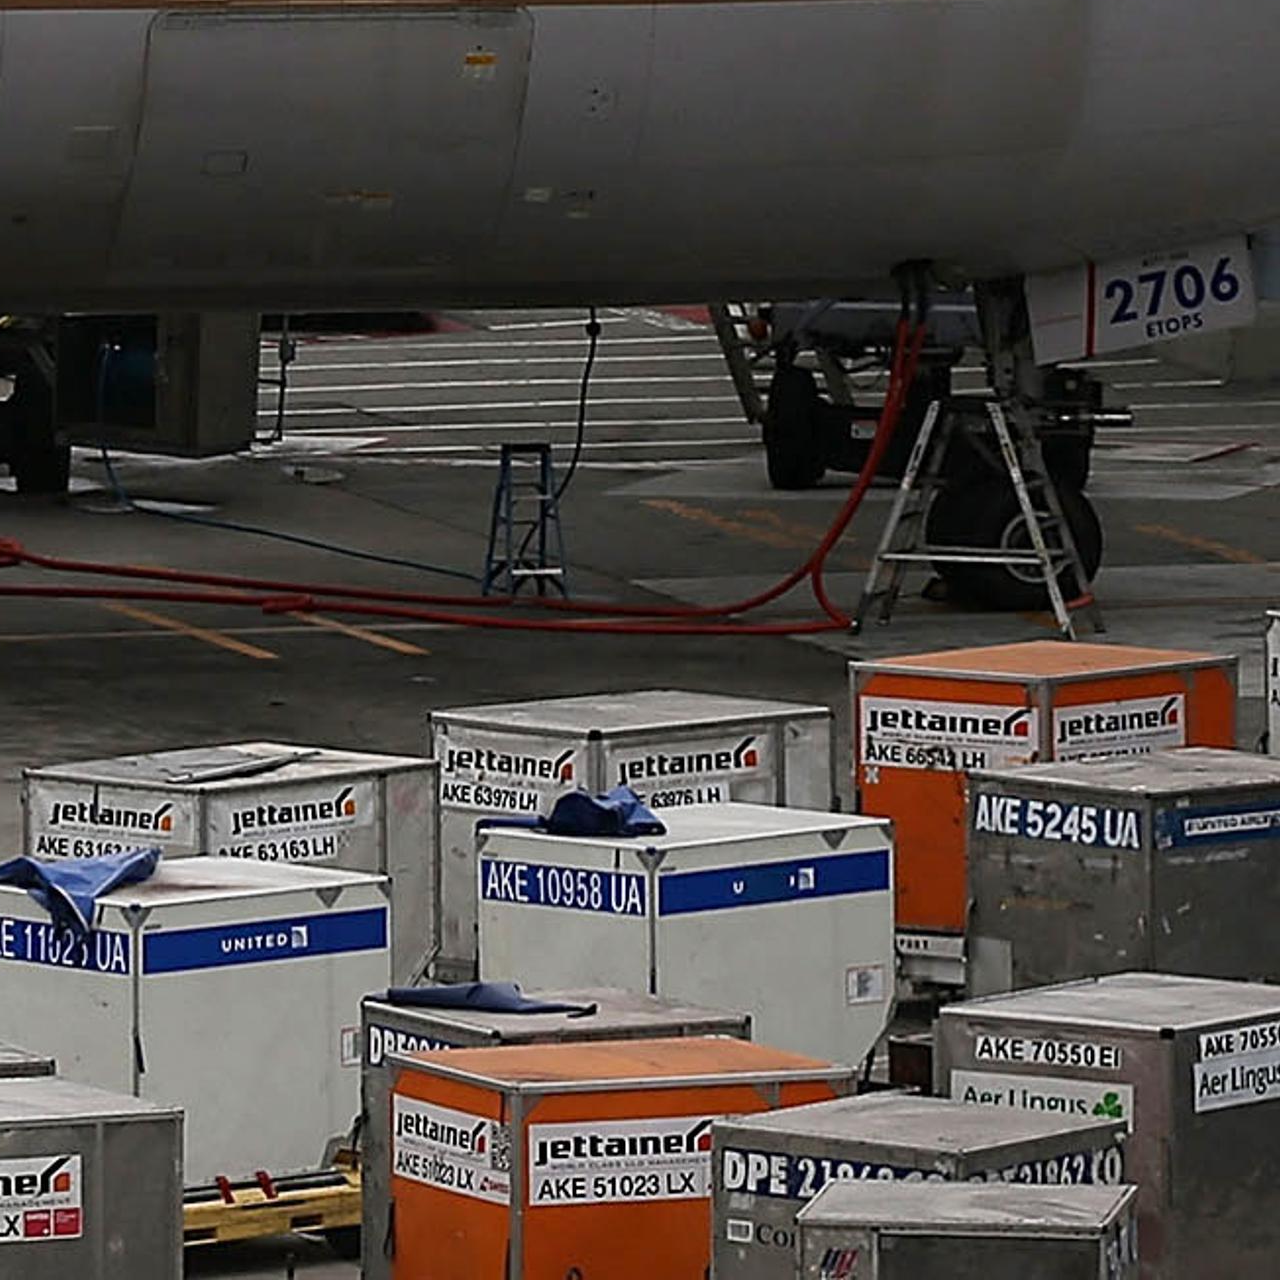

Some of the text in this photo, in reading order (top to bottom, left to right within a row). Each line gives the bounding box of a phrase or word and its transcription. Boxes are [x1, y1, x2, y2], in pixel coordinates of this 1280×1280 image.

[1105, 256, 1239, 325] 2706
[1146, 313, 1203, 338] ETOPS
[866, 708, 1032, 736] jettainer
[1057, 696, 1178, 743] jettainer
[445, 748, 575, 783] jettainer
[618, 737, 756, 785] jettainer
[865, 743, 902, 763] AKE
[962, 751, 986, 769] LH
[233, 786, 354, 835] jettainer
[442, 783, 538, 811] AKE 63976 LH
[976, 794, 1140, 849] AKE 5245 UA
[36, 835, 70, 857] AKE
[258, 838, 311, 861] 63163
[312, 835, 335, 857] LH
[486, 861, 642, 914] AKE 10958 UA
[96, 932, 126, 973] UA
[221, 934, 288, 953] UNITED
[978, 1038, 1119, 1067] AKE 70550 EI
[1239, 1025, 1280, 1051] 7055
[963, 1086, 1002, 1106] Aer
[1199, 1070, 1228, 1098] Aer
[396, 1112, 486, 1151] jettainer
[534, 1119, 713, 1167] jettainer
[457, 1168, 474, 1191] LX
[538, 1171, 695, 1200] AKE 51023 LX
[723, 1149, 787, 1196] DPE
